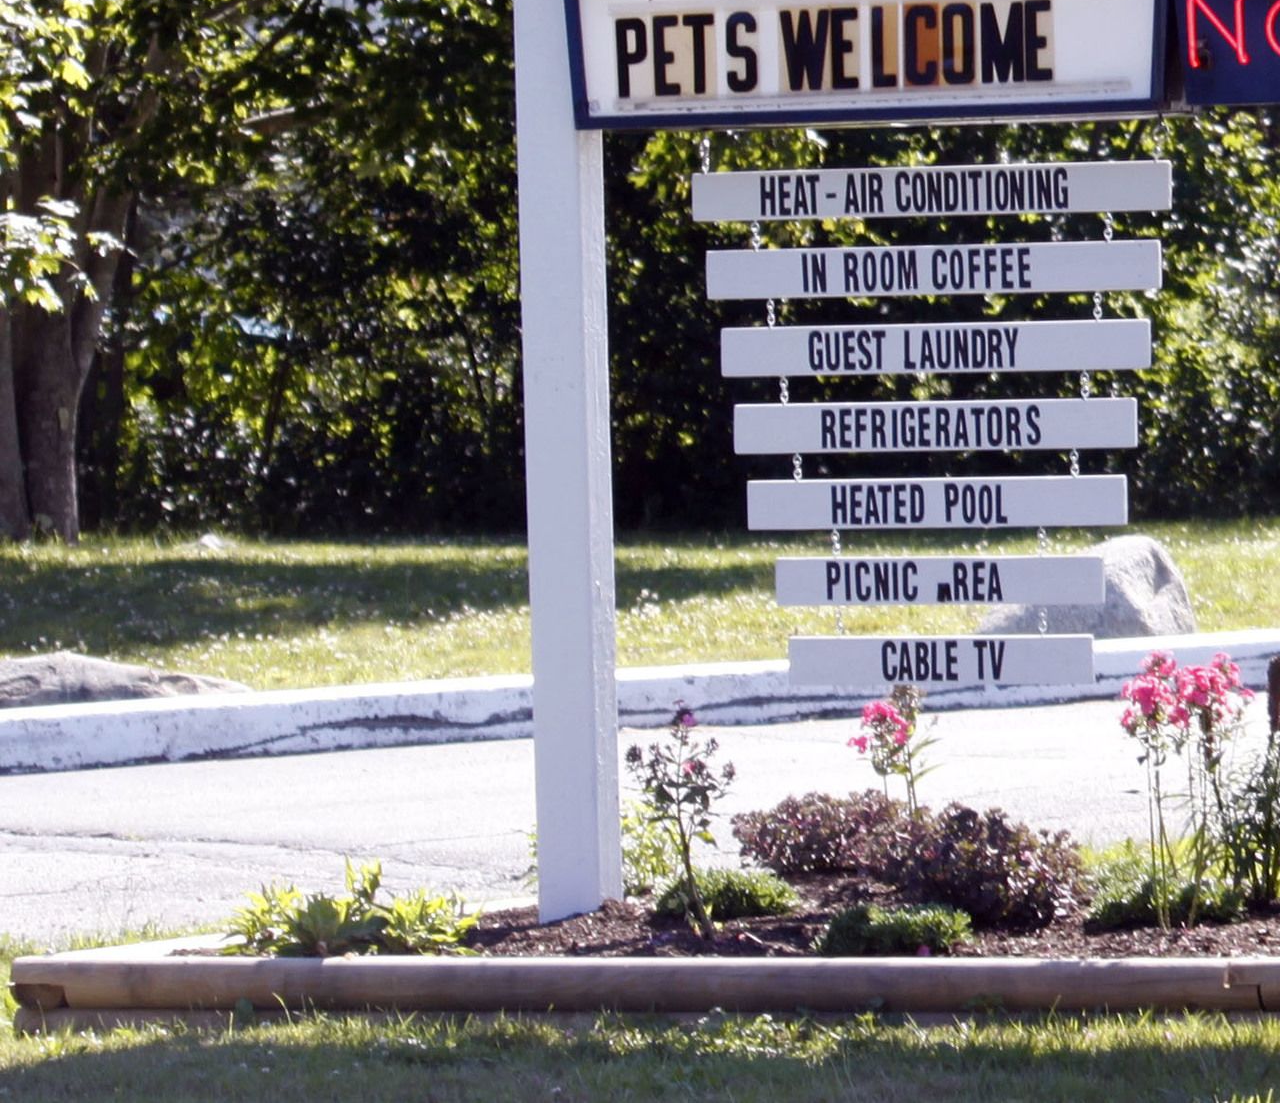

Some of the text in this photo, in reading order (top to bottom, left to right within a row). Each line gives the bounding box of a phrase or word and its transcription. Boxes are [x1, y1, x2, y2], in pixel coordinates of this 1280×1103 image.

[614, 14, 759, 99] PETS
[895, 167, 1069, 213] CONDITIONING
[801, 247, 1032, 293] IN ROOM COFFEE
[808, 327, 1019, 371] GUEST LAUNDRY
[821, 404, 1042, 449] REFRIGERATORS
[830, 483, 1009, 525] HEATED POOL
[826, 561, 919, 603] PICNIC
[880, 639, 1006, 682] CABLE TV
